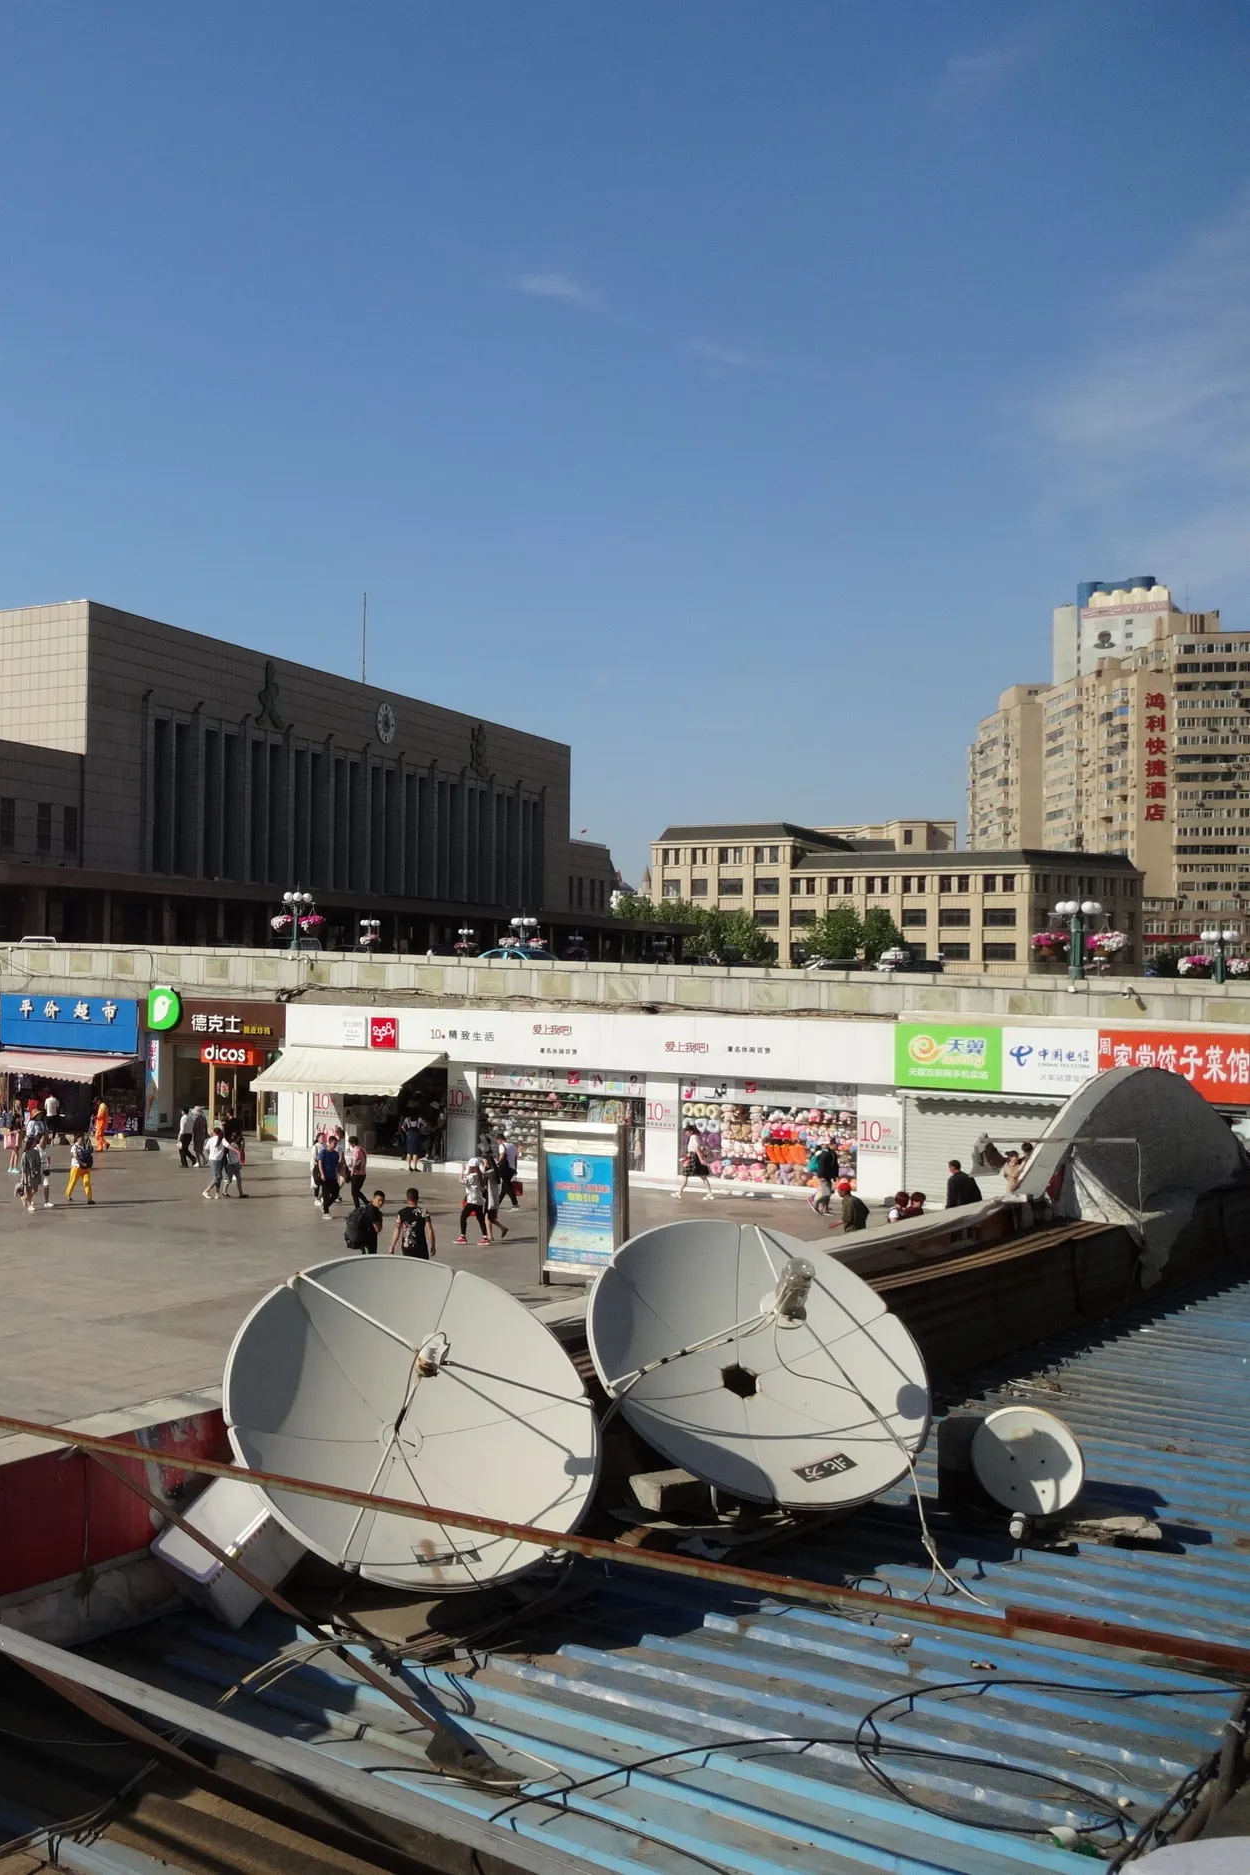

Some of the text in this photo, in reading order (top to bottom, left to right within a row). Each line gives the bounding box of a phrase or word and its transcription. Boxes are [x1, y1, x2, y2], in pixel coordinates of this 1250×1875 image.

[1144, 692, 1167, 822] 鸿利快捷酒店
[19, 999, 119, 1024] 平价超市
[191, 1014, 241, 1033] 德克士
[448, 1029, 495, 1042] 精致生活
[204, 1044, 246, 1062] dicos
[946, 1038, 984, 1056] 天翼
[1038, 1048, 1090, 1062] 中国电信
[1098, 1037, 1111, 1056] 周
[804, 1457, 849, 1480] 北方
